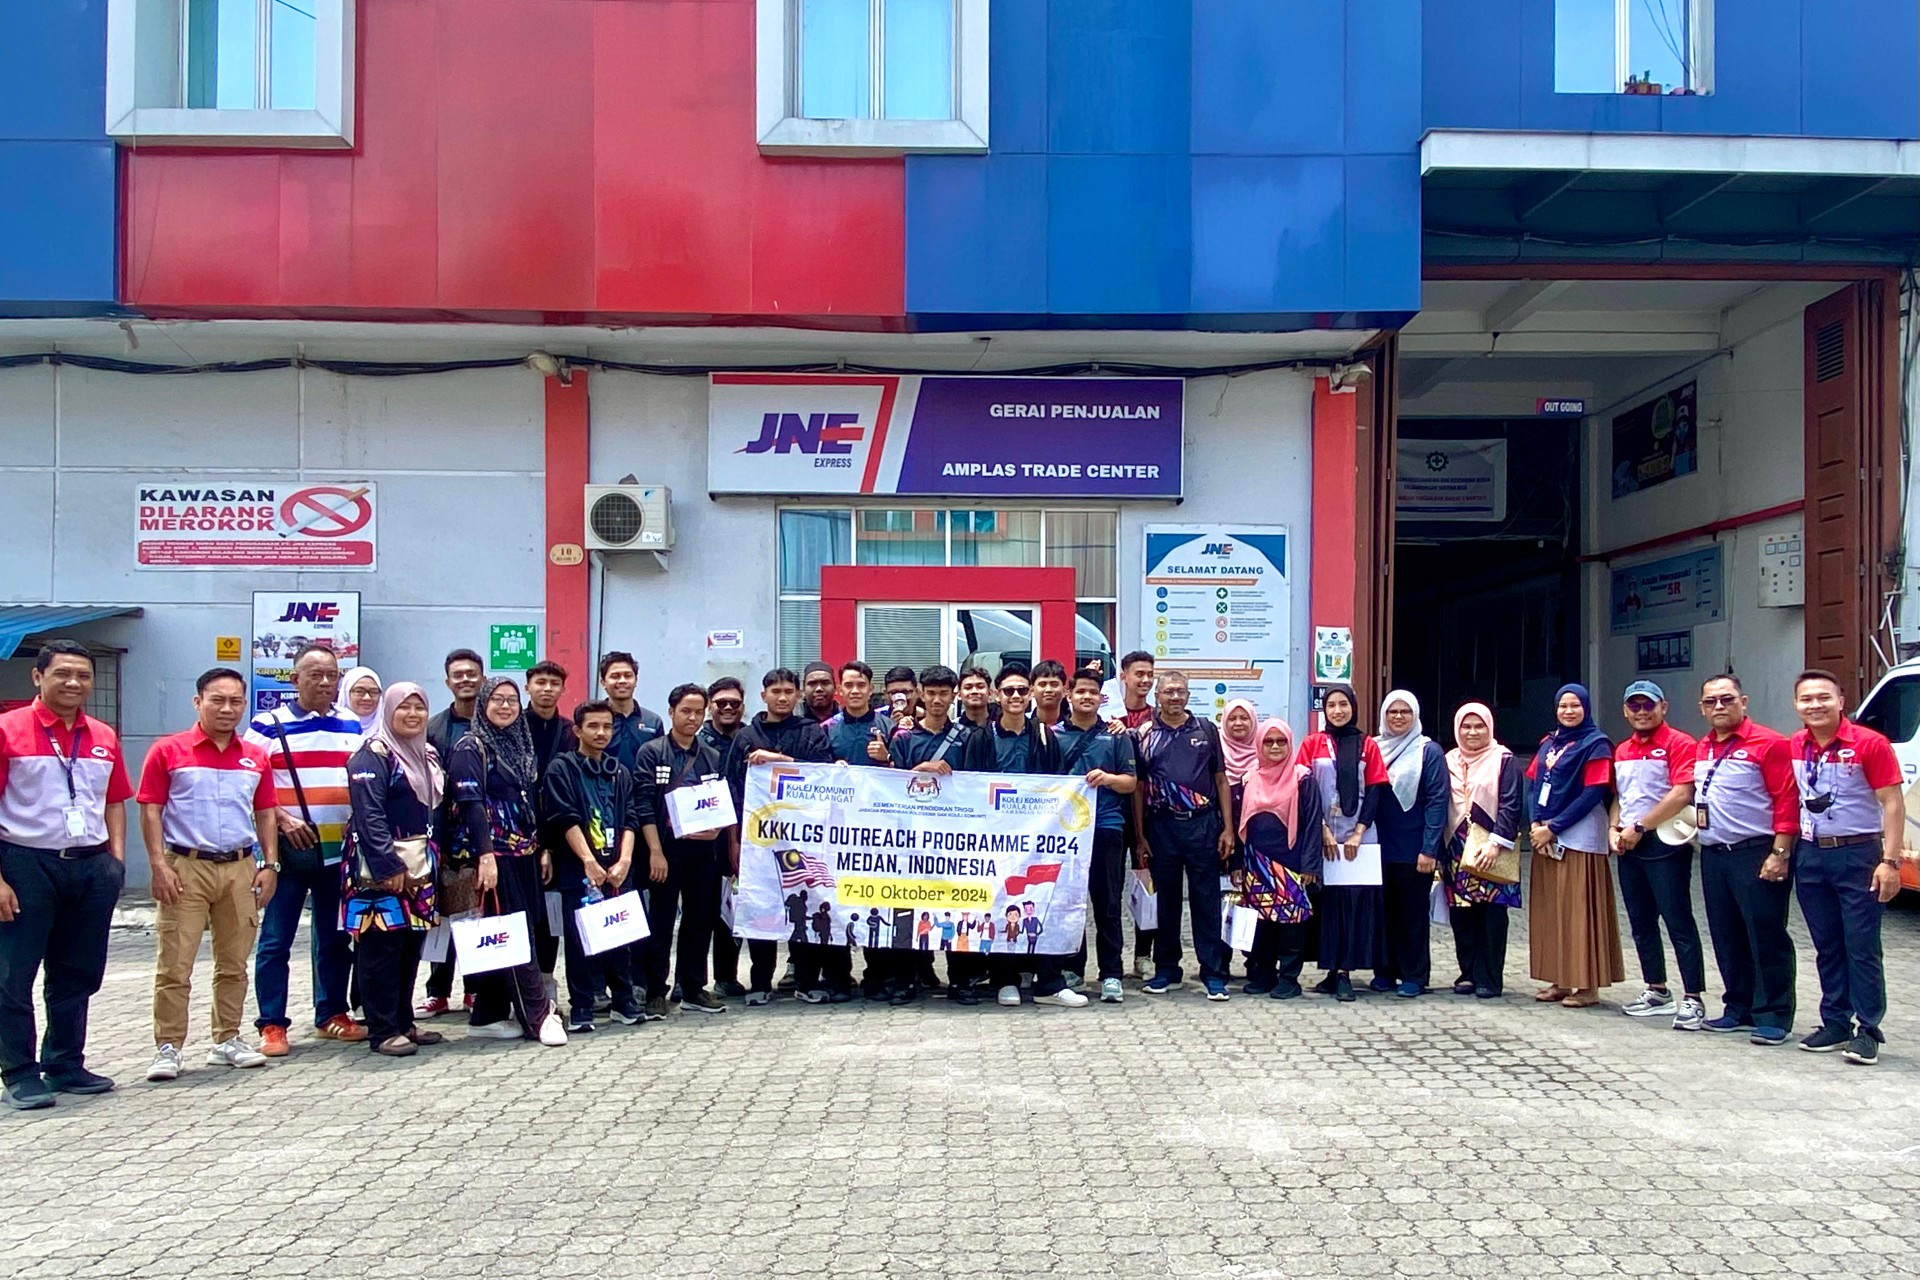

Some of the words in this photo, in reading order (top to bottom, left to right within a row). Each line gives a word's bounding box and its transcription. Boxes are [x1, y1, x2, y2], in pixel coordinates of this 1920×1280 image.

[990, 404, 1045, 418] GERAI
[1051, 405, 1160, 419] PENJUALAN
[1544, 401, 1559, 412] OUT
[1560, 402, 1583, 412] GOING
[740, 413, 865, 454] JNE
[814, 458, 852, 468] EXPRESS
[942, 463, 1016, 477] AMPLAS
[1021, 463, 1081, 478] TRADE
[1087, 464, 1160, 478] CENTER
[140, 489, 274, 502] KAWASAN
[140, 506, 274, 518] DILARANG
[140, 519, 275, 531] MEROKOK
[1201, 543, 1233, 555] JNE
[1167, 565, 1217, 574] SELAMAT
[1221, 566, 1264, 575] DATANG
[276, 602, 340, 622] JNE
[786, 783, 813, 793] KOLEJ
[813, 785, 855, 796] KOMUNITI
[786, 790, 816, 800] KUALA
[819, 794, 855, 803] LANGAT
[694, 796, 719, 811] JNE
[1002, 796, 1024, 804] KOLEJ
[758, 819, 824, 843] KKKLCS
[829, 826, 916, 848] OUTREACH
[922, 830, 1030, 852] PROGRAMME
[1036, 834, 1079, 855] 2024
[836, 852, 902, 875] MEDAN,
[908, 855, 997, 877] INDONESIA
[844, 884, 874, 898] 7-10
[880, 884, 945, 901] Oktober
[951, 888, 988, 902] 2024
[602, 909, 630, 928] JNE
[476, 931, 510, 949] JNE
